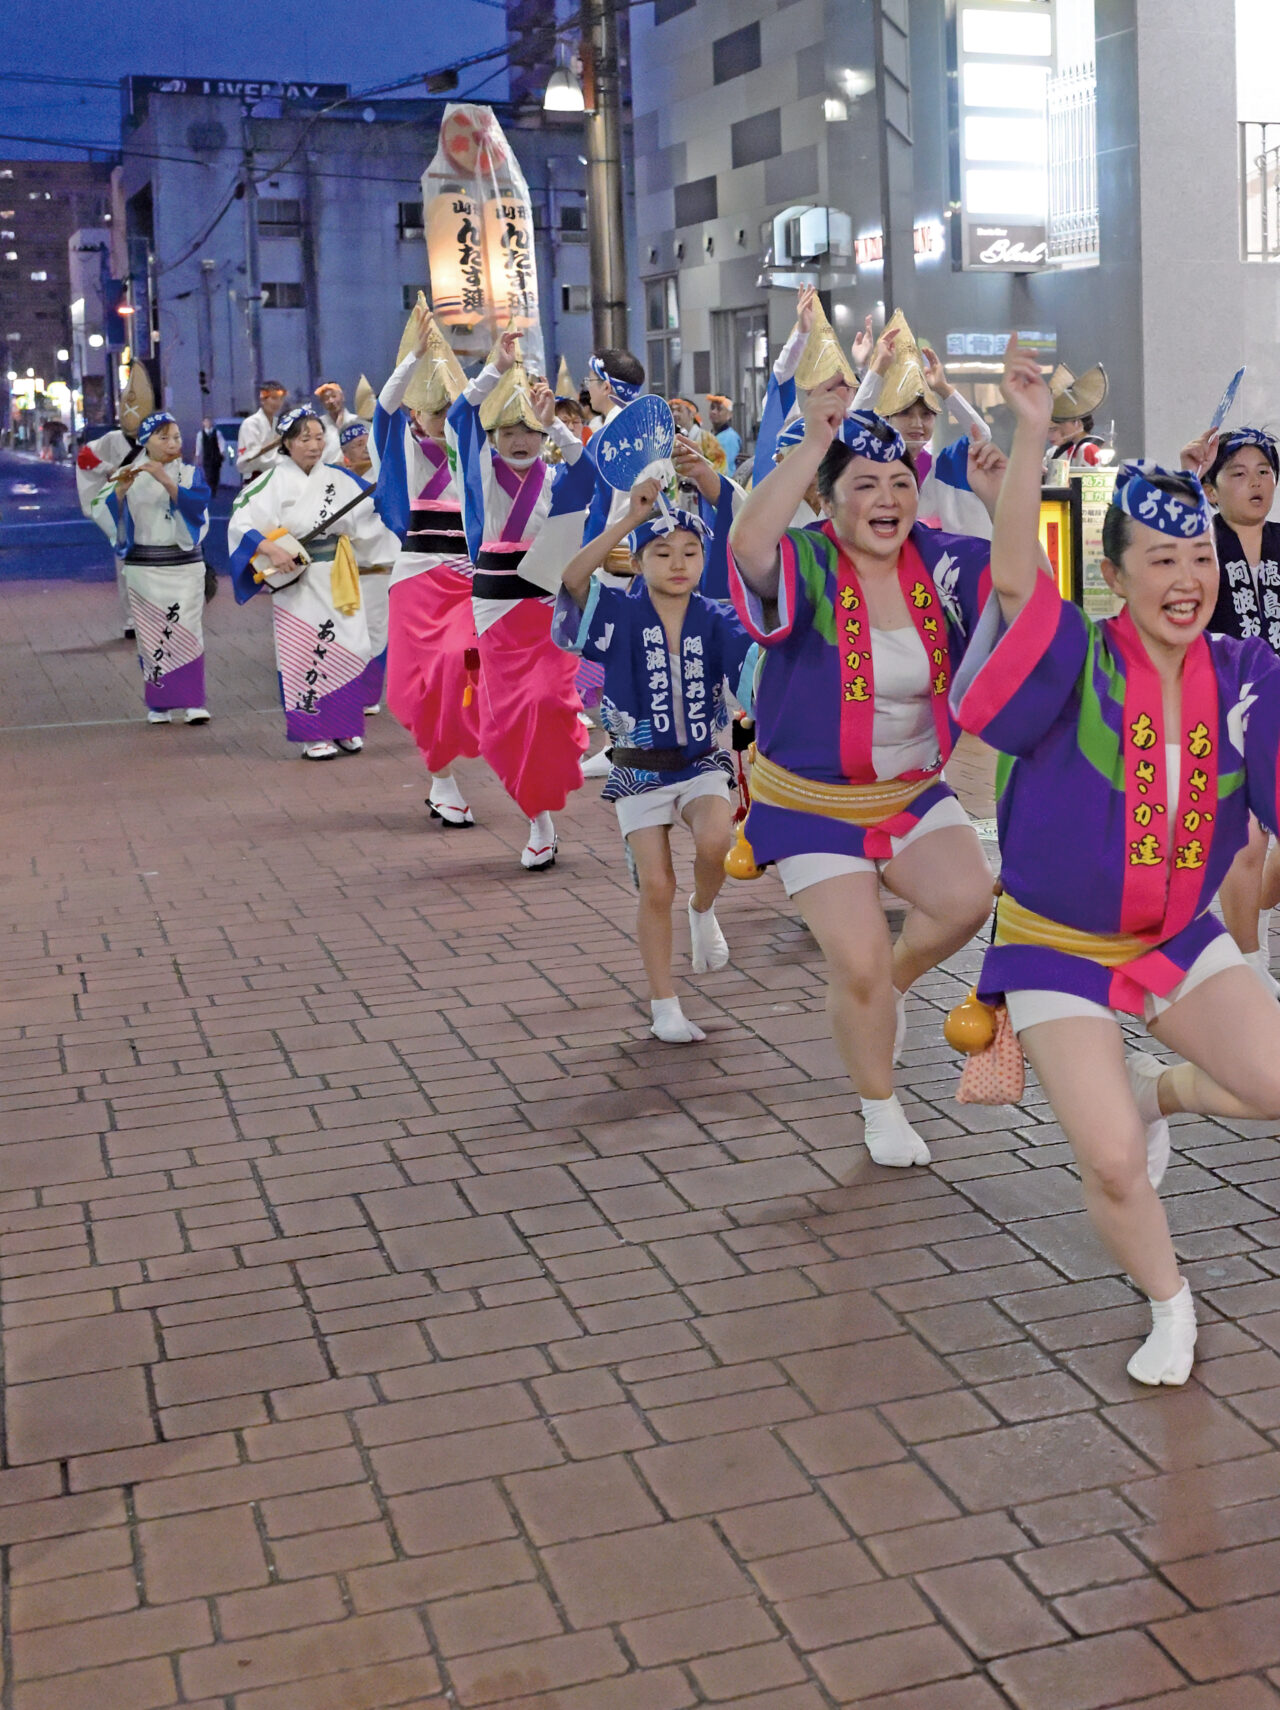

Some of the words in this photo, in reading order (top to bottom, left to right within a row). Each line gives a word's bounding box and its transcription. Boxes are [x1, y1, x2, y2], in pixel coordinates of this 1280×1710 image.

[294, 618, 336, 715] あさか連
[642, 625, 670, 733] 阿波おどり
[683, 635, 708, 742] 阿波おどり
[839, 585, 872, 702] あさか連
[909, 581, 949, 697] あさか連
[1129, 711, 1167, 867] あさか連
[1174, 720, 1215, 870] あさか連
